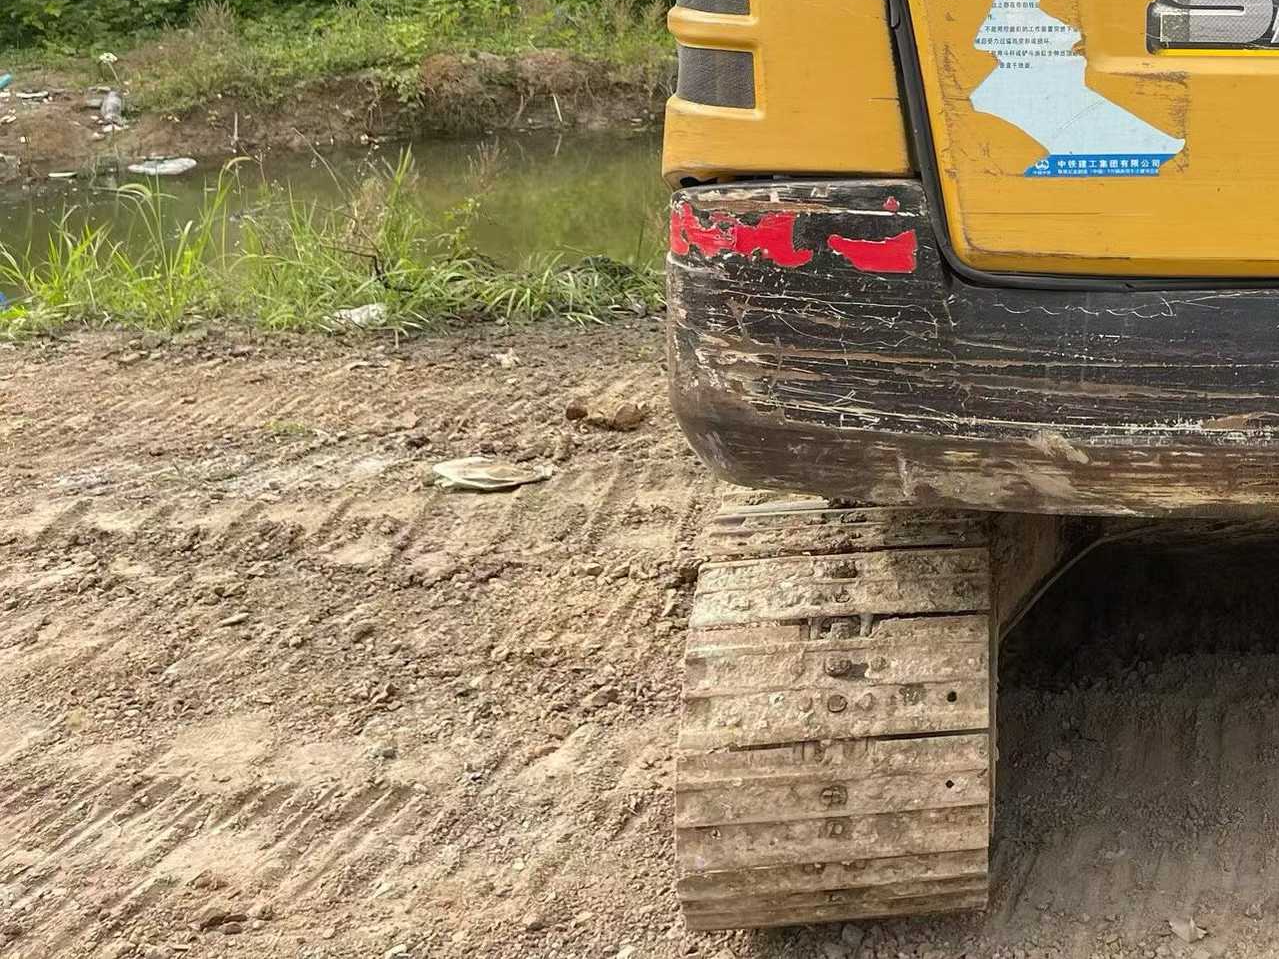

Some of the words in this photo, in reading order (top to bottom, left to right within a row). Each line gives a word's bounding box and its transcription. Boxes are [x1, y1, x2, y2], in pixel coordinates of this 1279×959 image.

[1057, 159, 1161, 169] 中铁建工集团有限公司
